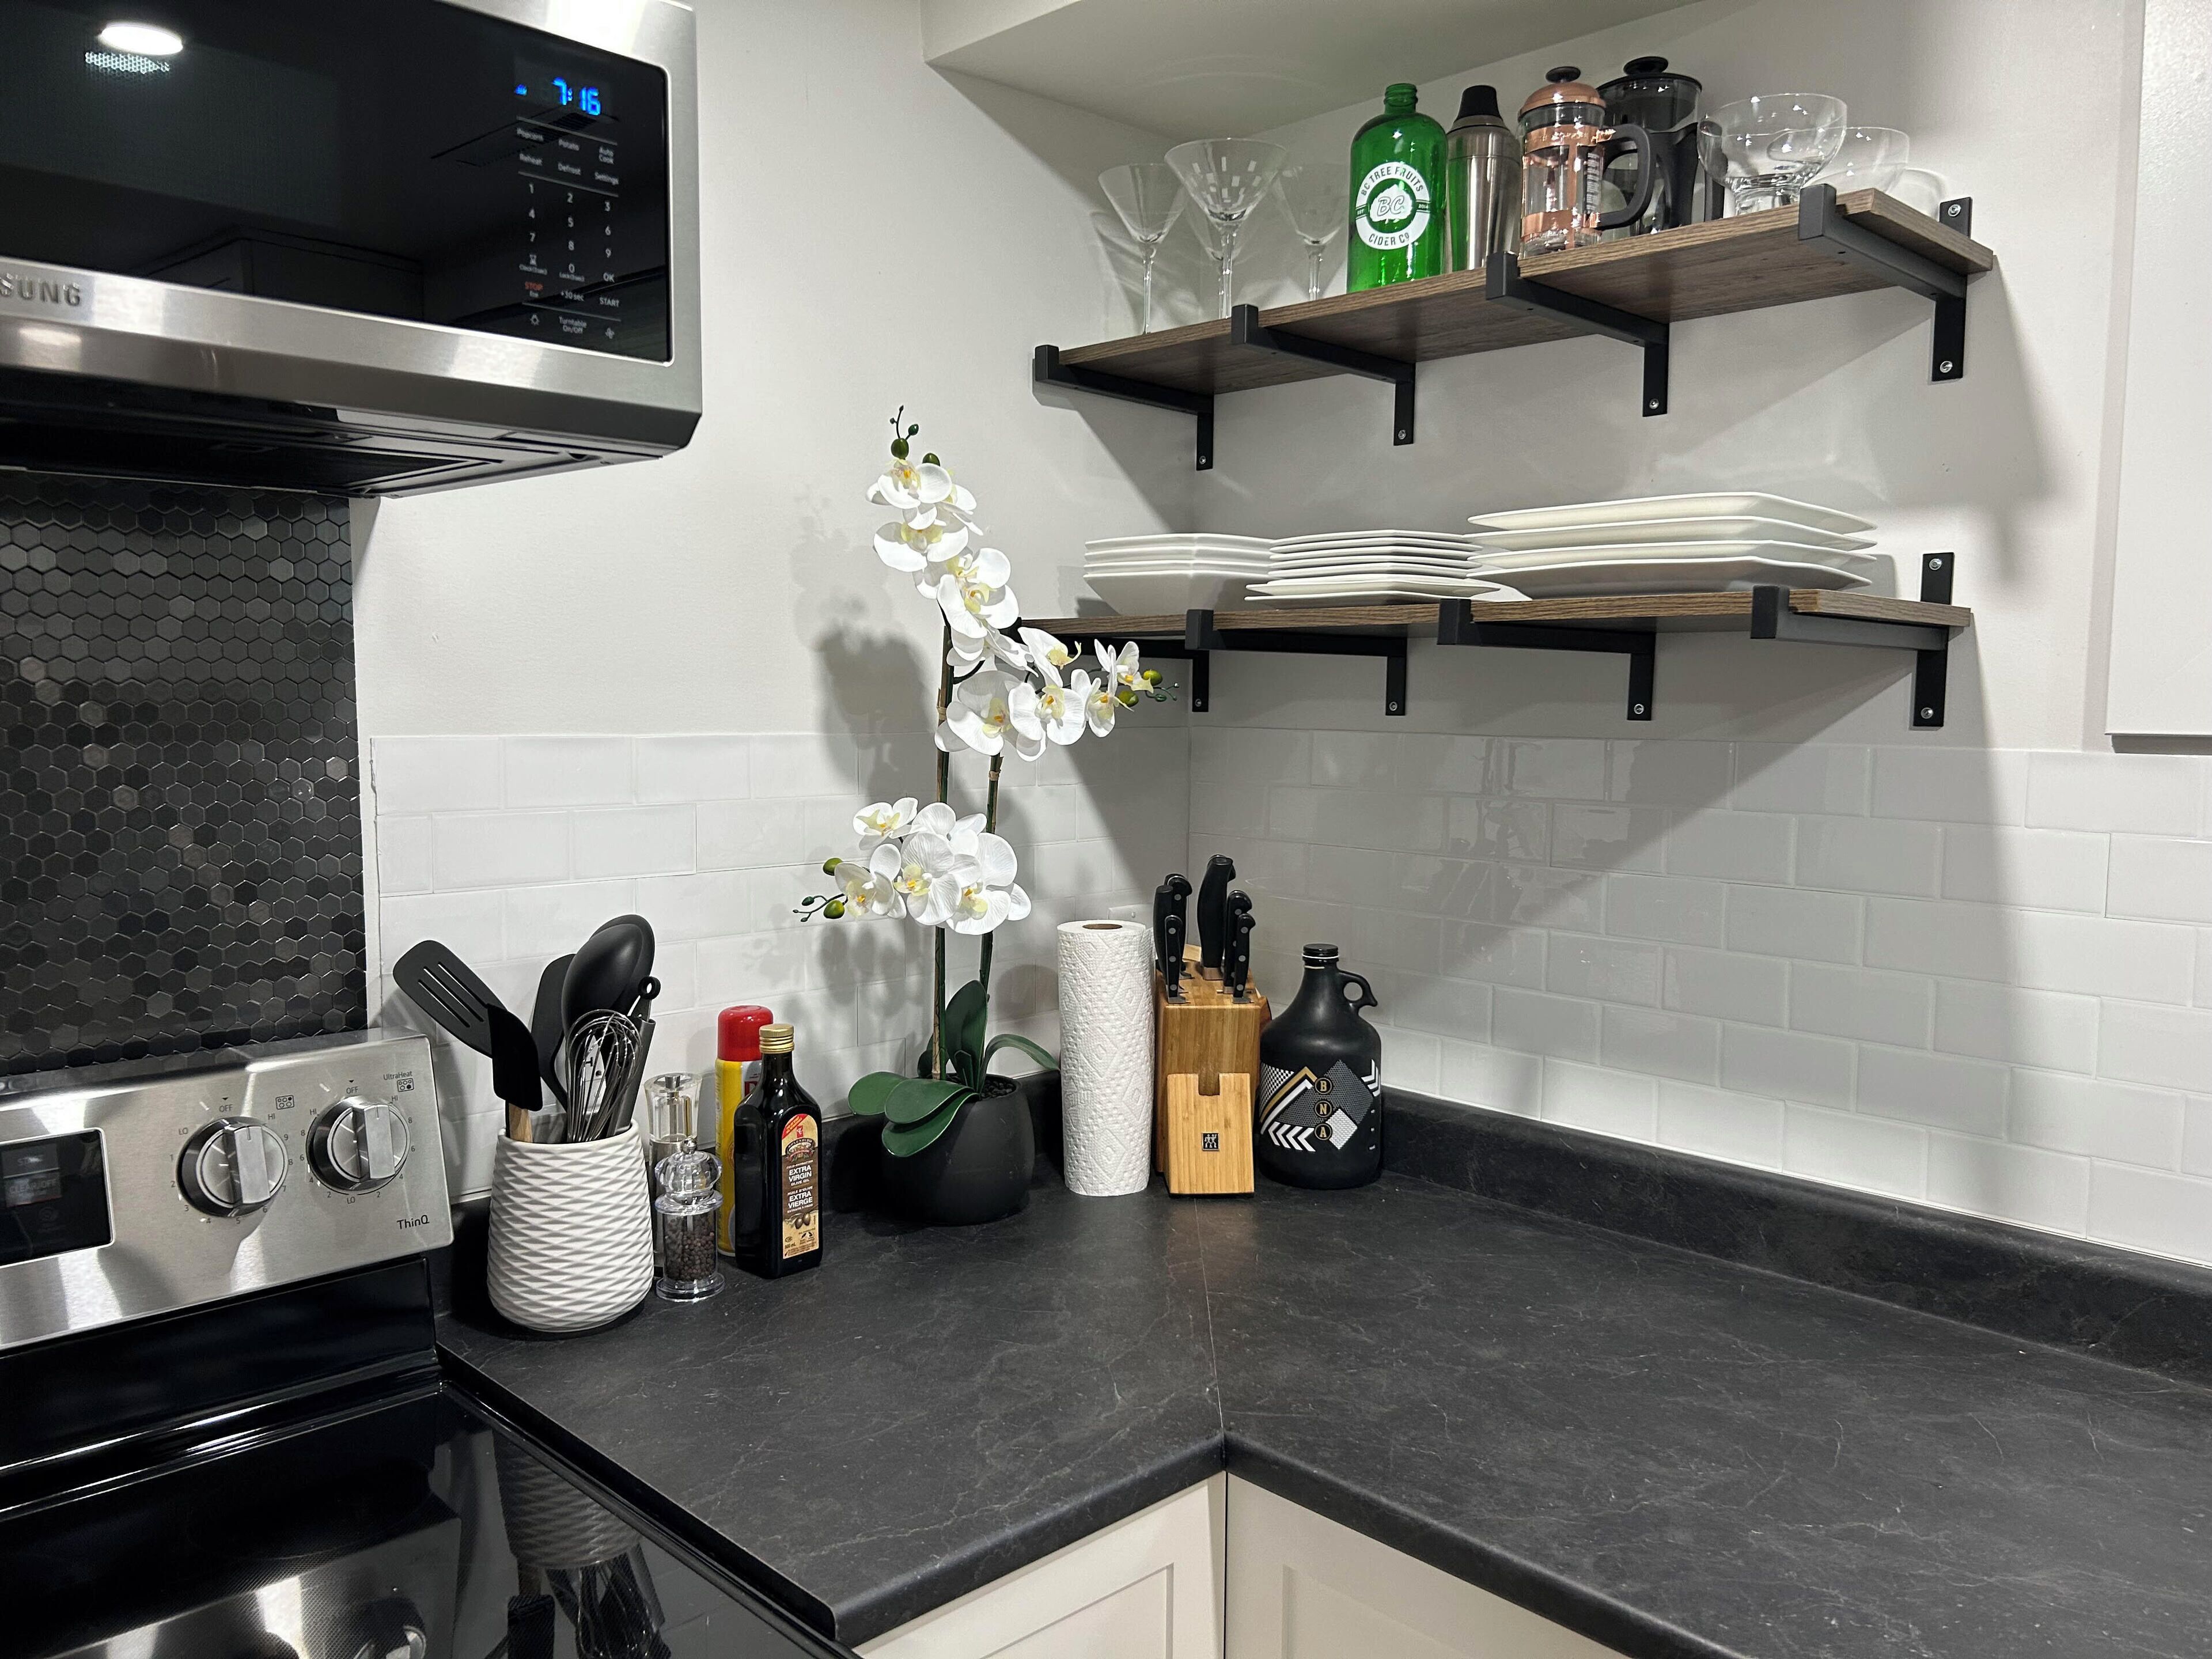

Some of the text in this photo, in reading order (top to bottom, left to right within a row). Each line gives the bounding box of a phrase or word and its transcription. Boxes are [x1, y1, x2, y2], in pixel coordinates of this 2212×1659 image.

[551, 77, 602, 116] 7:16
[519, 153, 543, 166] Reheat
[558, 162, 581, 176] Defrost
[594, 172, 619, 186] Settings
[1361, 166, 1424, 196] BC TREE FRUITS
[529, 183, 534, 194] 1
[567, 192, 573, 203] 2
[605, 202, 611, 212] 3
[1377, 195, 1404, 217] BC
[528, 207, 535, 219] 4
[567, 217, 574, 228] 5
[605, 225, 611, 236] 6
[529, 232, 536, 242] 7
[1368, 233, 1396, 246] CIDER
[568, 240, 574, 251] 8
[605, 248, 612, 259] 9
[569, 263, 575, 274] 0
[603, 272, 615, 283] OK
[524, 281, 543, 291] STOP
[560, 290, 585, 302] +30 sec
[599, 297, 620, 308] START
[559, 316, 588, 328] Turntable
[562, 325, 584, 334] On/Off
[383, 1071, 412, 1081] UltraHeat
[346, 1086, 359, 1094] OFF
[1320, 1081, 1327, 1092] B
[219, 1104, 233, 1112] OFF
[1319, 1103, 1327, 1115] N
[1319, 1127, 1327, 1138] A
[789, 1165, 812, 1176] EXTRA
[788, 1171, 812, 1182] VIRGIN
[347, 1196, 355, 1204] LO
[789, 1191, 812, 1202] EXTRA
[788, 1196, 813, 1209] VIERGE
[396, 1215, 430, 1229] ThinQ
